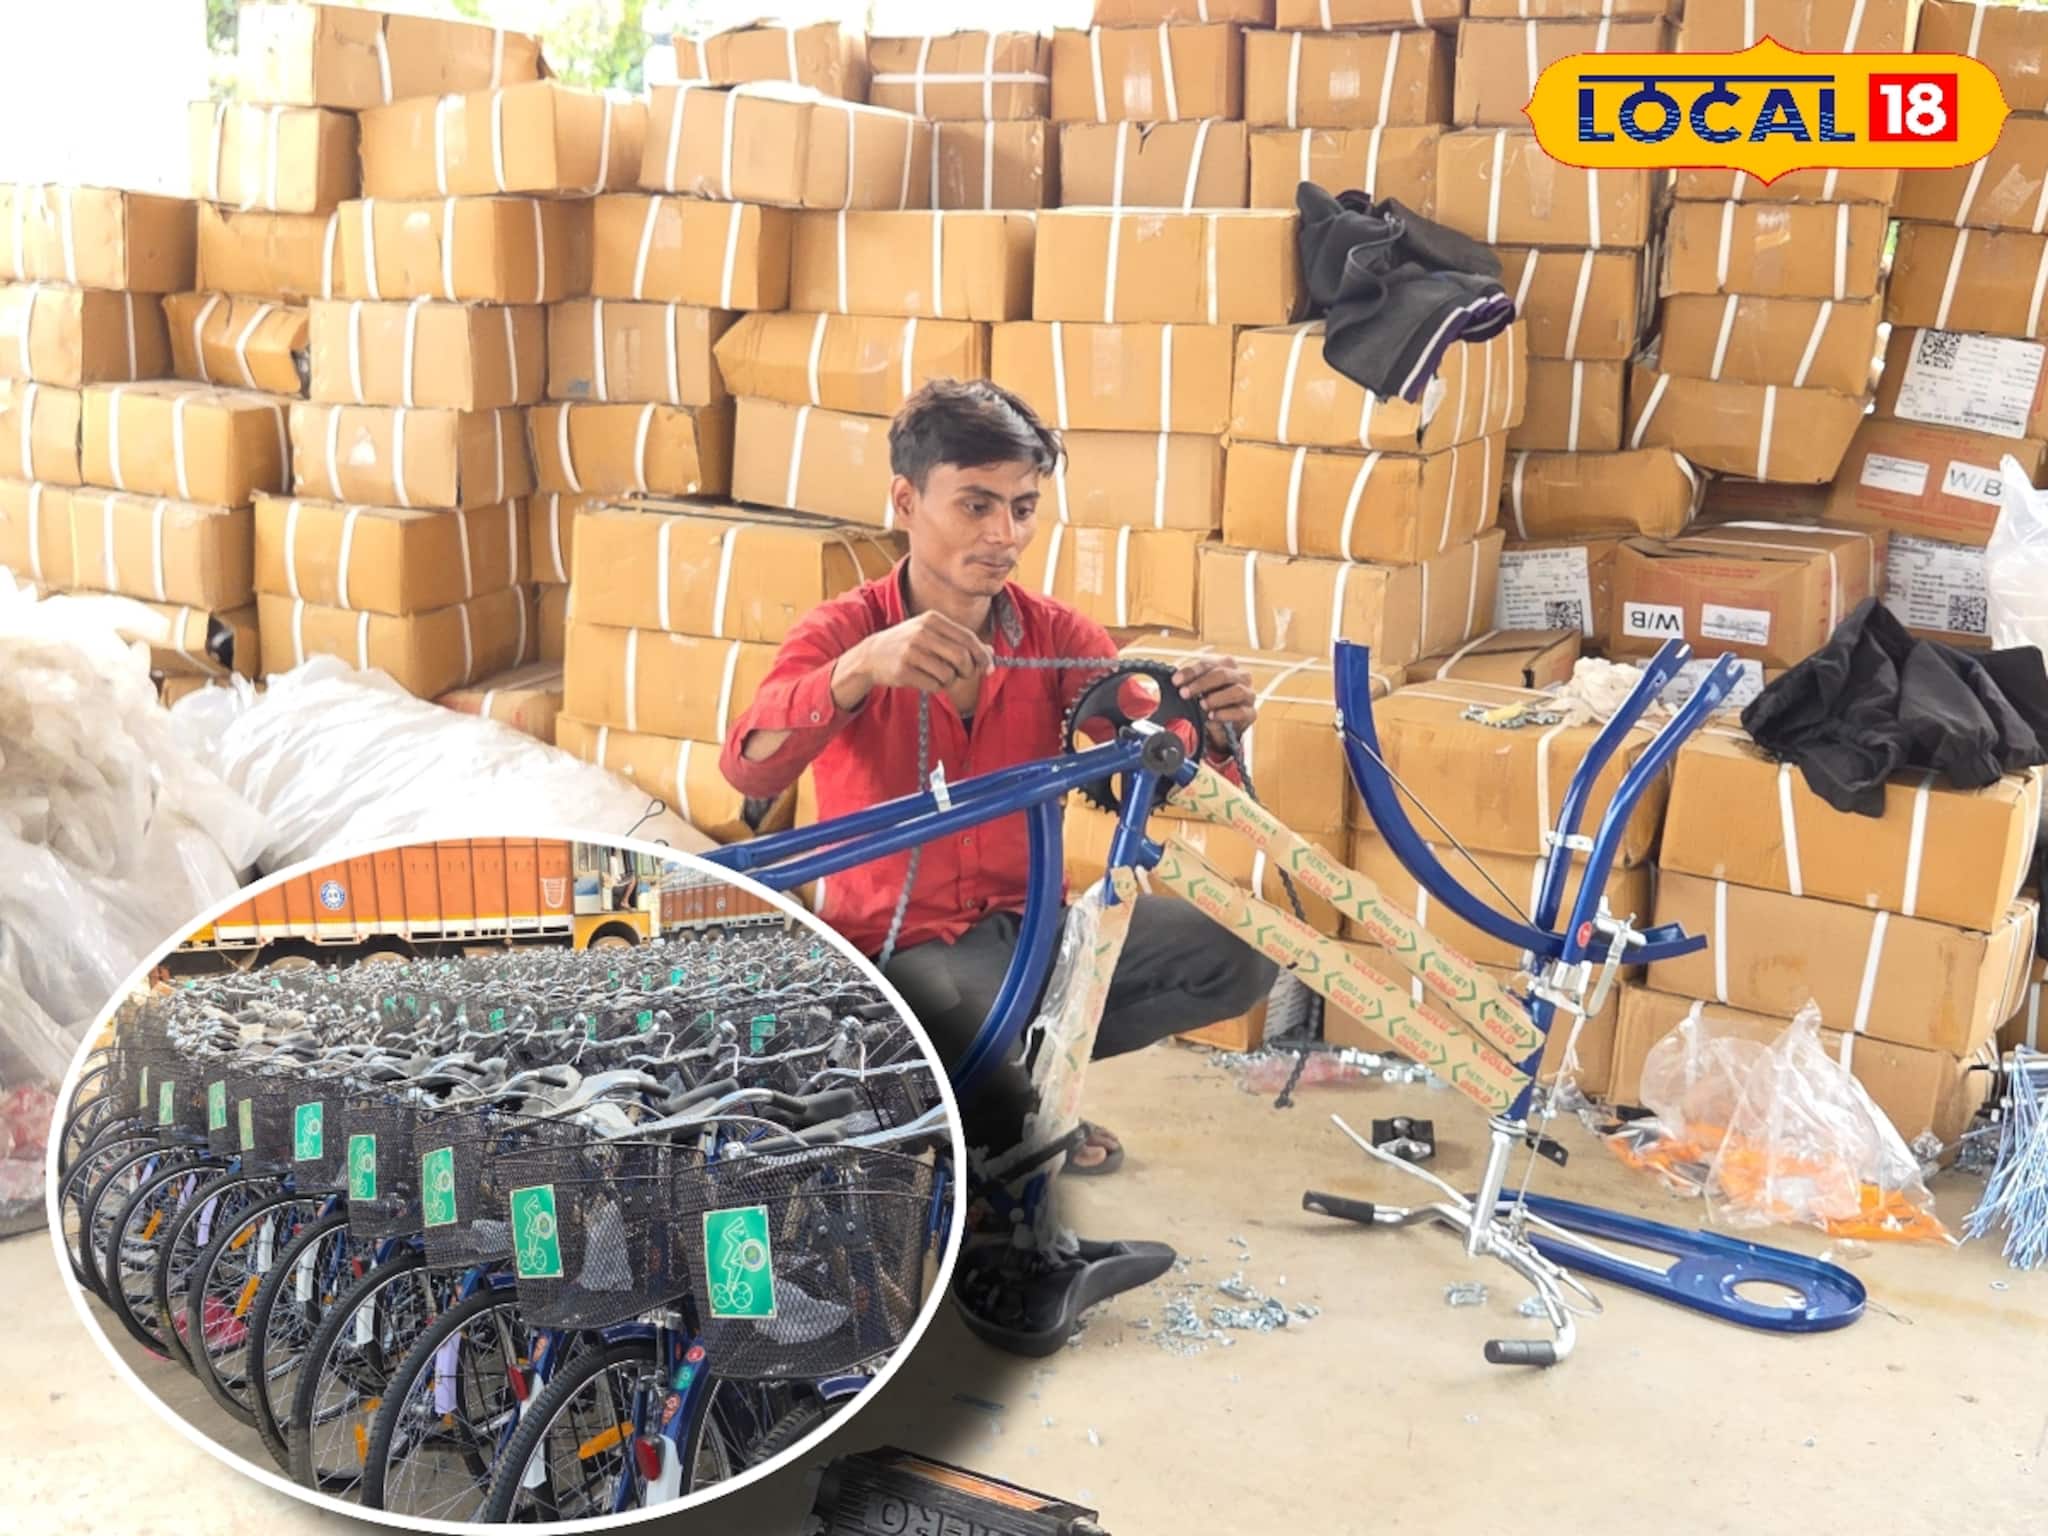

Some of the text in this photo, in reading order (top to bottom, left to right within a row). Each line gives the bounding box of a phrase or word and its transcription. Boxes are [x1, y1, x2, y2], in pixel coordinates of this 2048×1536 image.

[1950, 468, 2002, 497] W/B
[1631, 610, 1680, 632] W/B
[1231, 816, 1268, 847] GOLD
[1297, 868, 1335, 898] GOLD
[1362, 919, 1399, 949] GOLD
[1351, 960, 1388, 987] GOLD
[1423, 969, 1459, 999] GOLD
[1330, 989, 1365, 1016] GOLD
[1415, 1005, 1451, 1033] GOLD
[1482, 1017, 1518, 1046] GOLD
[1394, 1033, 1430, 1062] GOLD
[1478, 1049, 1515, 1078] GOLD
[1458, 1078, 1494, 1106] GOLD
